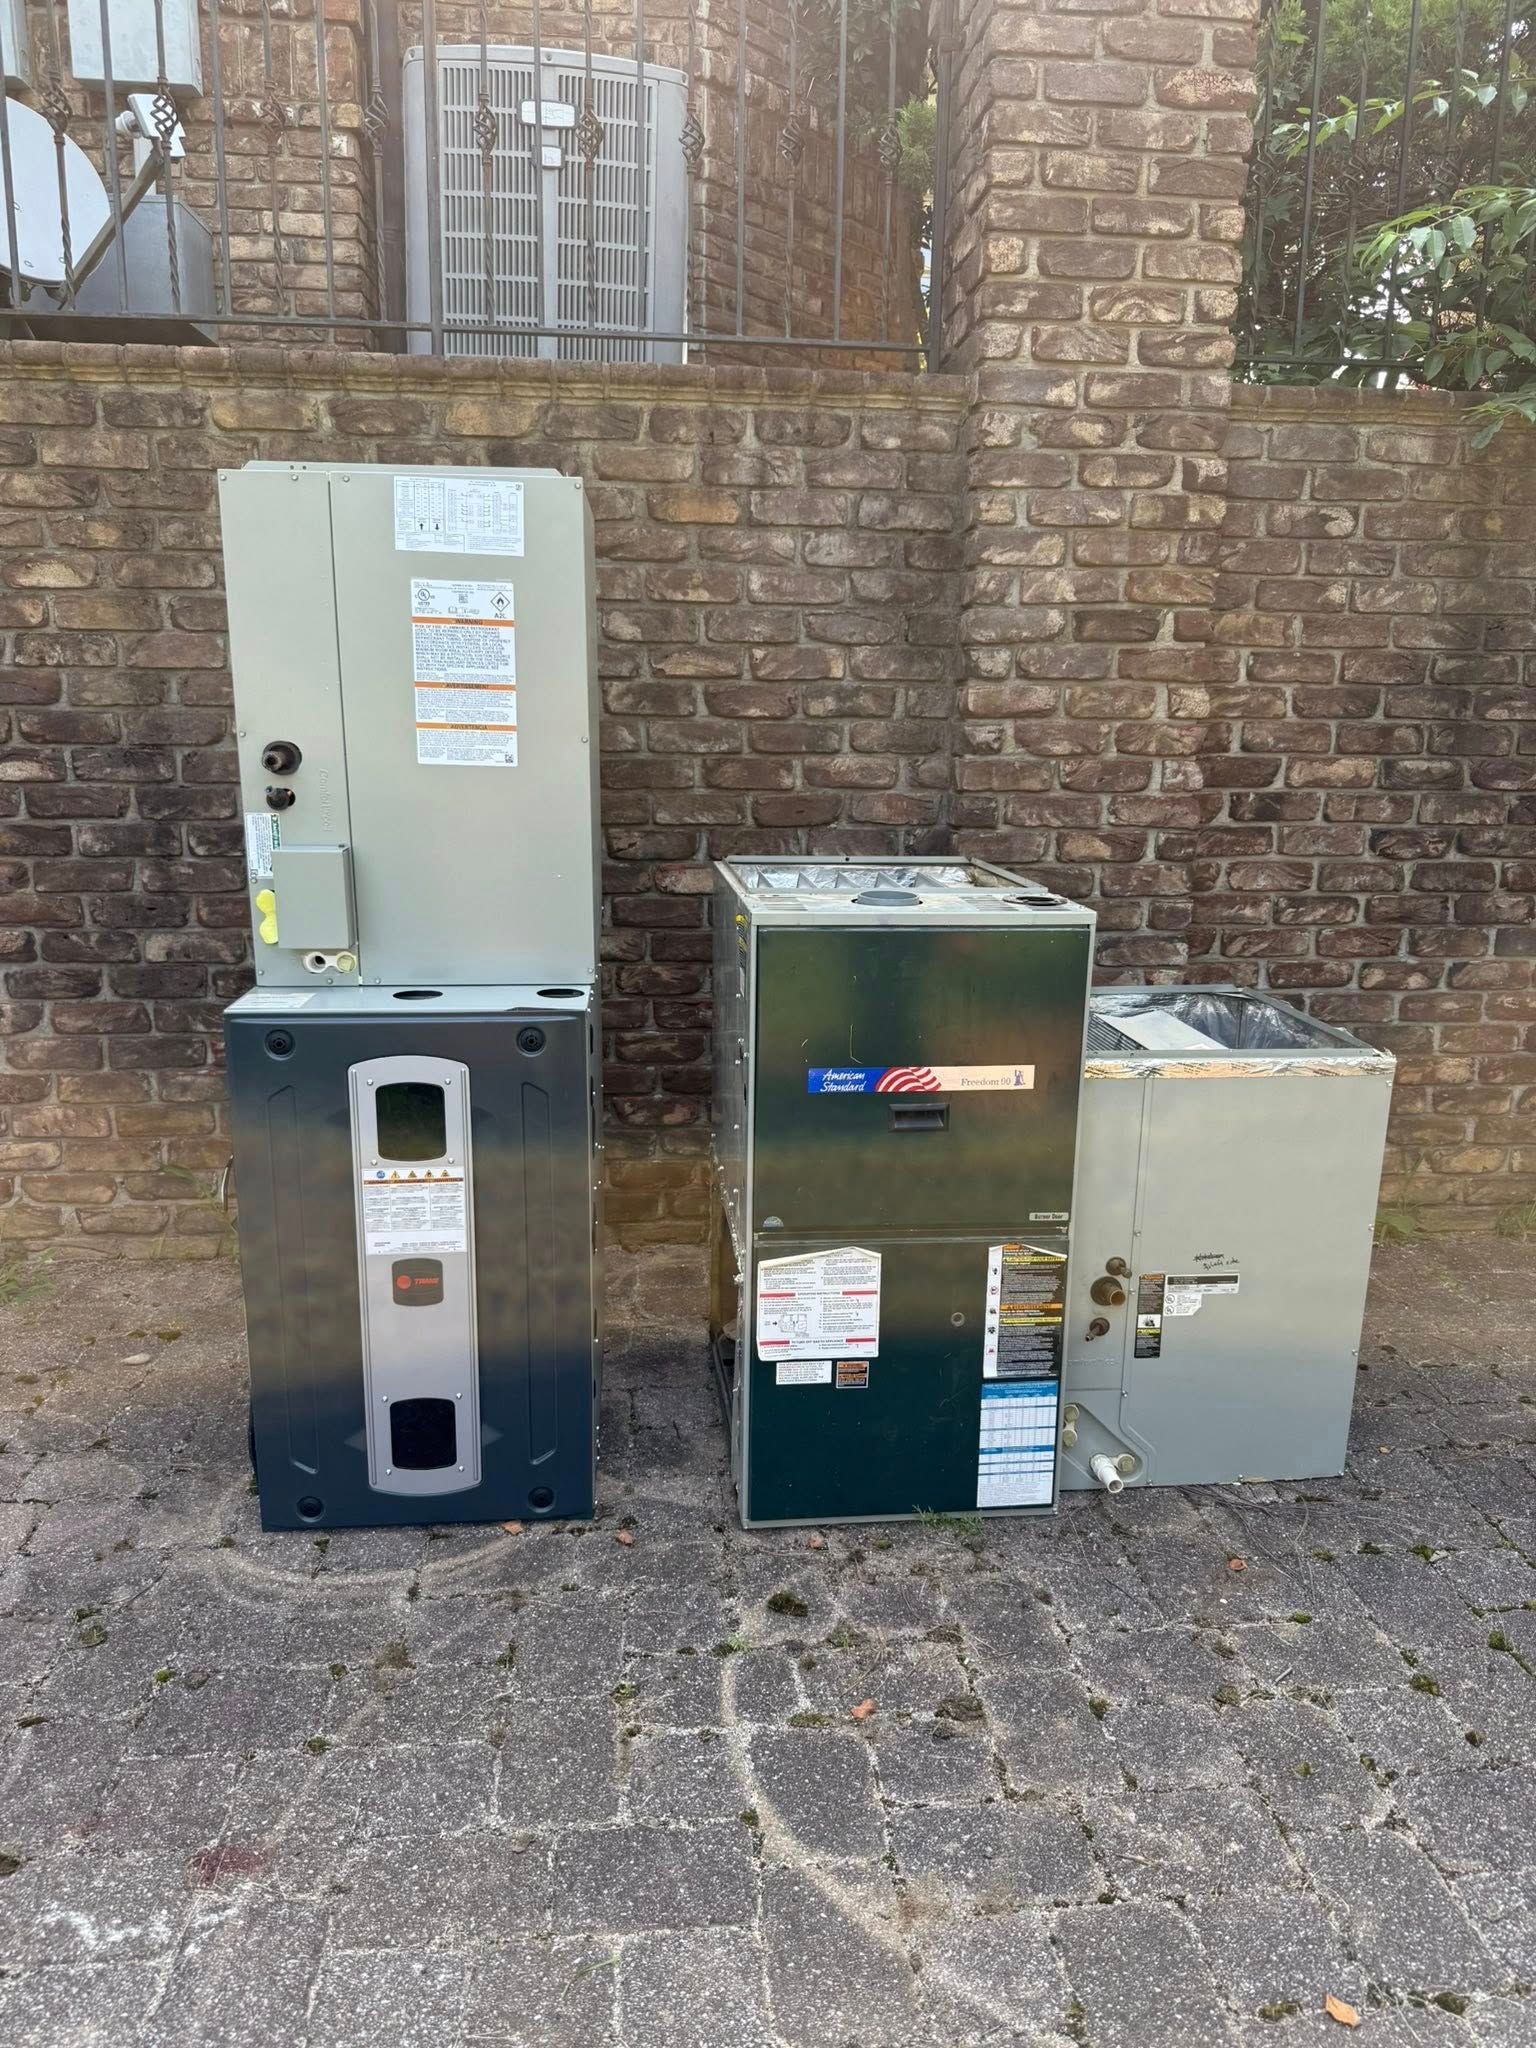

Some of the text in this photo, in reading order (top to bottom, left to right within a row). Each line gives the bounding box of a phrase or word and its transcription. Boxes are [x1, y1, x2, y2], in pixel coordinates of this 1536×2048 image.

[822, 1069, 865, 1081] American
[820, 1081, 867, 1092] Standard
[961, 1078, 999, 1086] Freedom
